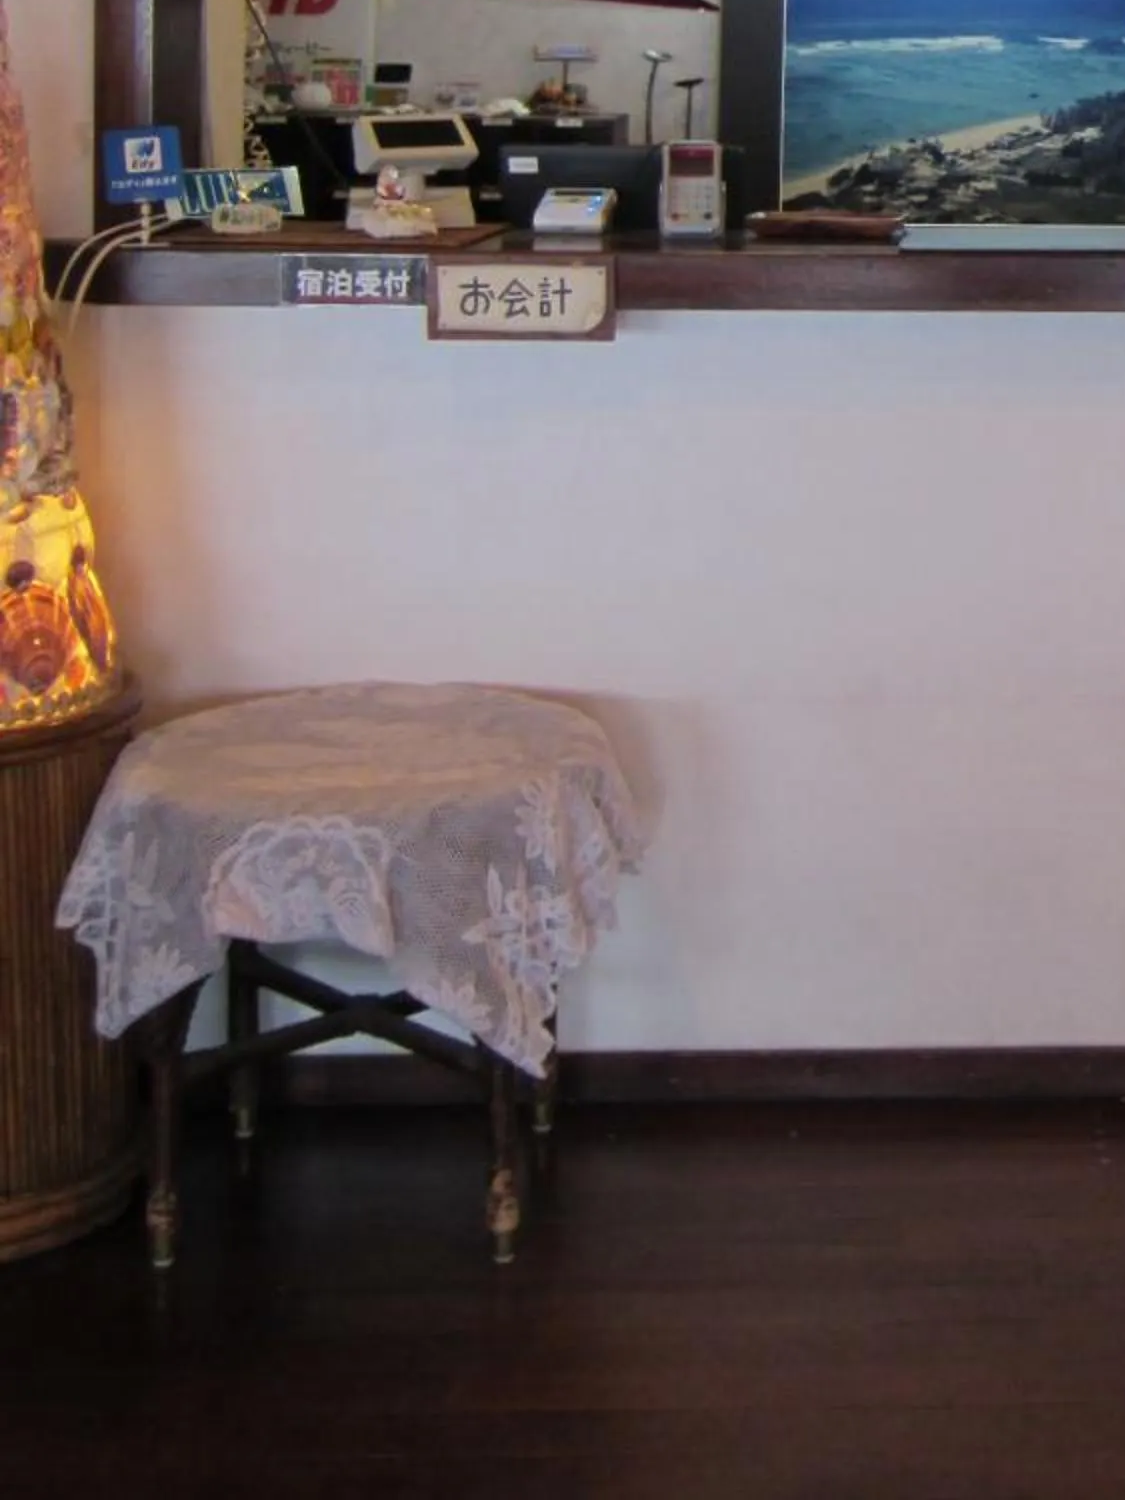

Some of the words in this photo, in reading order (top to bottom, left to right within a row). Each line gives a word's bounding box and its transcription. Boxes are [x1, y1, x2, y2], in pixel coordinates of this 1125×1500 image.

[297, 269, 411, 298] 宿泊受付
[458, 275, 573, 318] お会計
